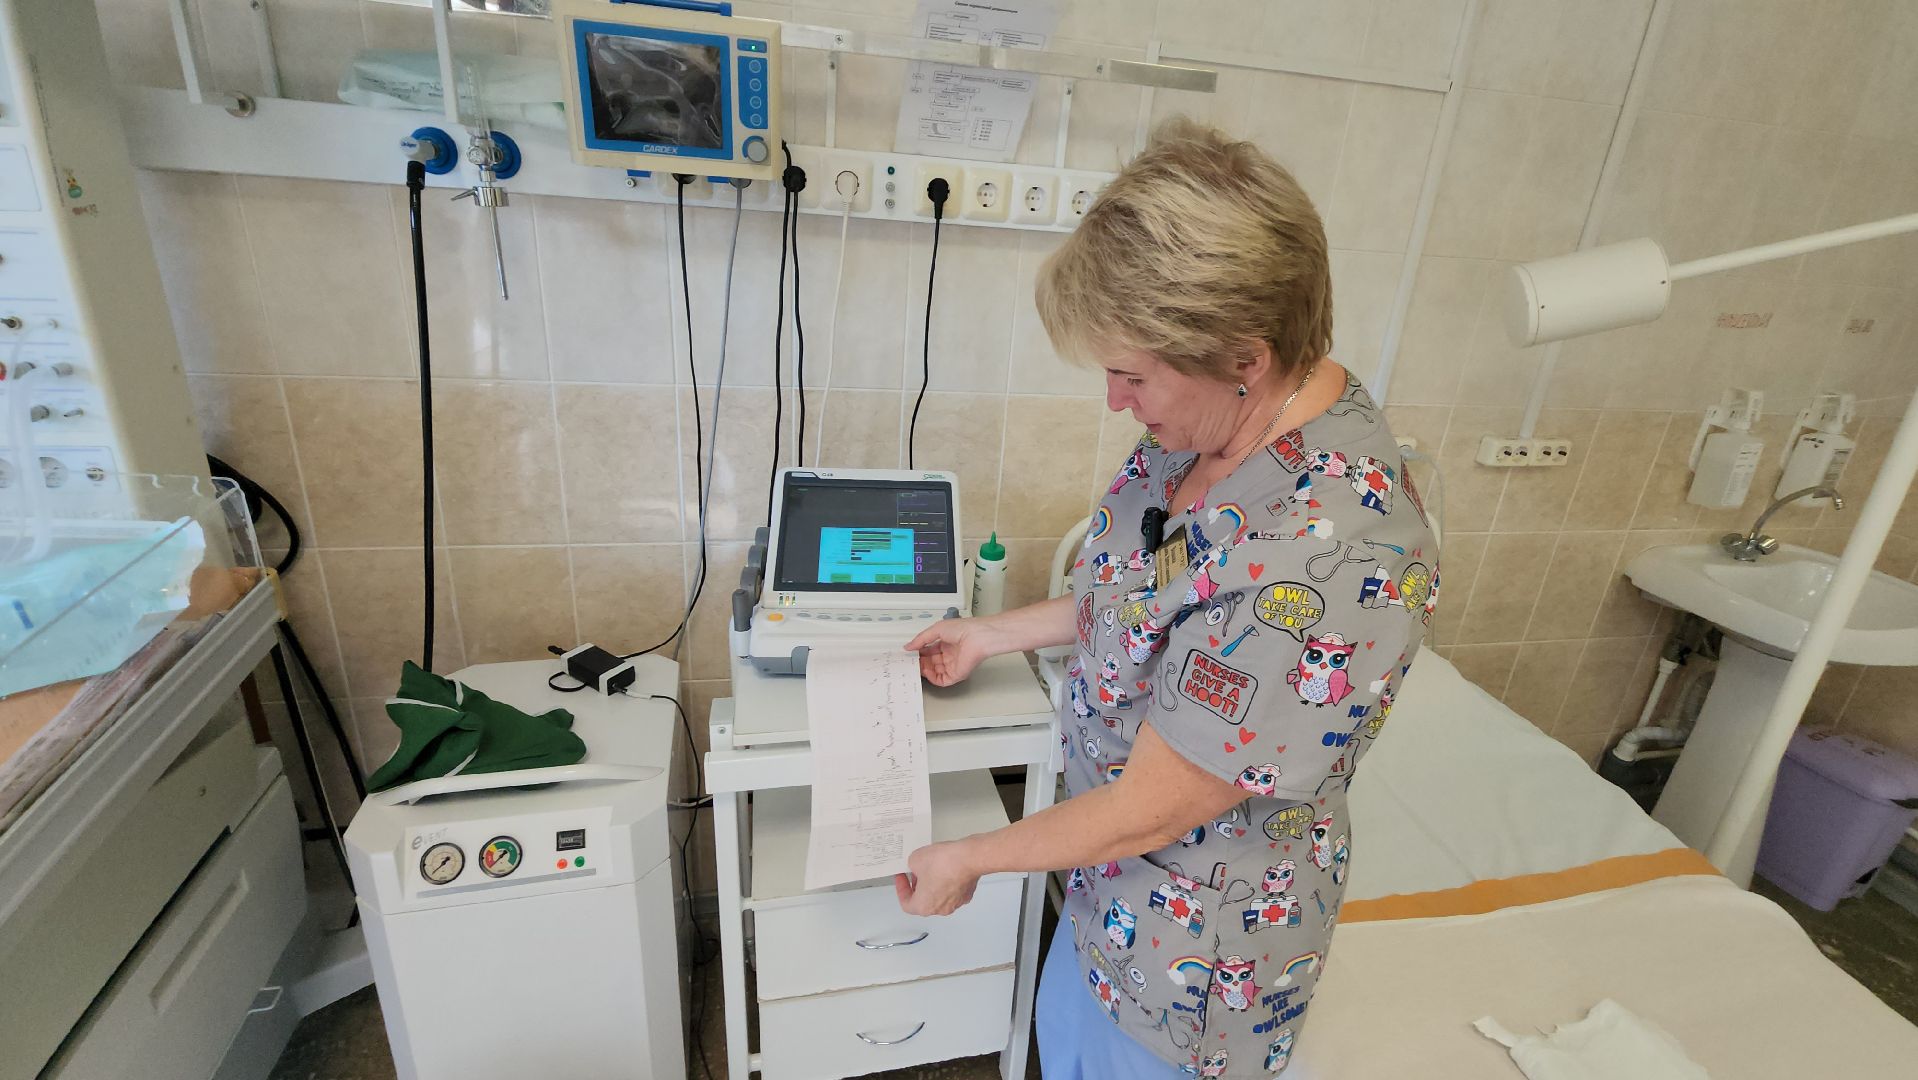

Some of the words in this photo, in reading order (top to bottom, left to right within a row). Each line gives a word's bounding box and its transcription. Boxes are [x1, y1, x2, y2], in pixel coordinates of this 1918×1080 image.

[642, 144, 678, 155] CARDEX
[1273, 586, 1310, 606] OWL
[1258, 597, 1287, 613] TAKE
[1290, 605, 1322, 619] CARE
[1263, 612, 1277, 620] OF
[1279, 614, 1304, 629] YOU
[1194, 654, 1250, 689] NURSES
[1192, 668, 1226, 694] GIVE
[1227, 687, 1240, 702] A
[1185, 679, 1239, 718] HOOT!
[1278, 806, 1305, 822] OWL
[1262, 986, 1301, 1008] NURSES
[1272, 997, 1289, 1016] ARE
